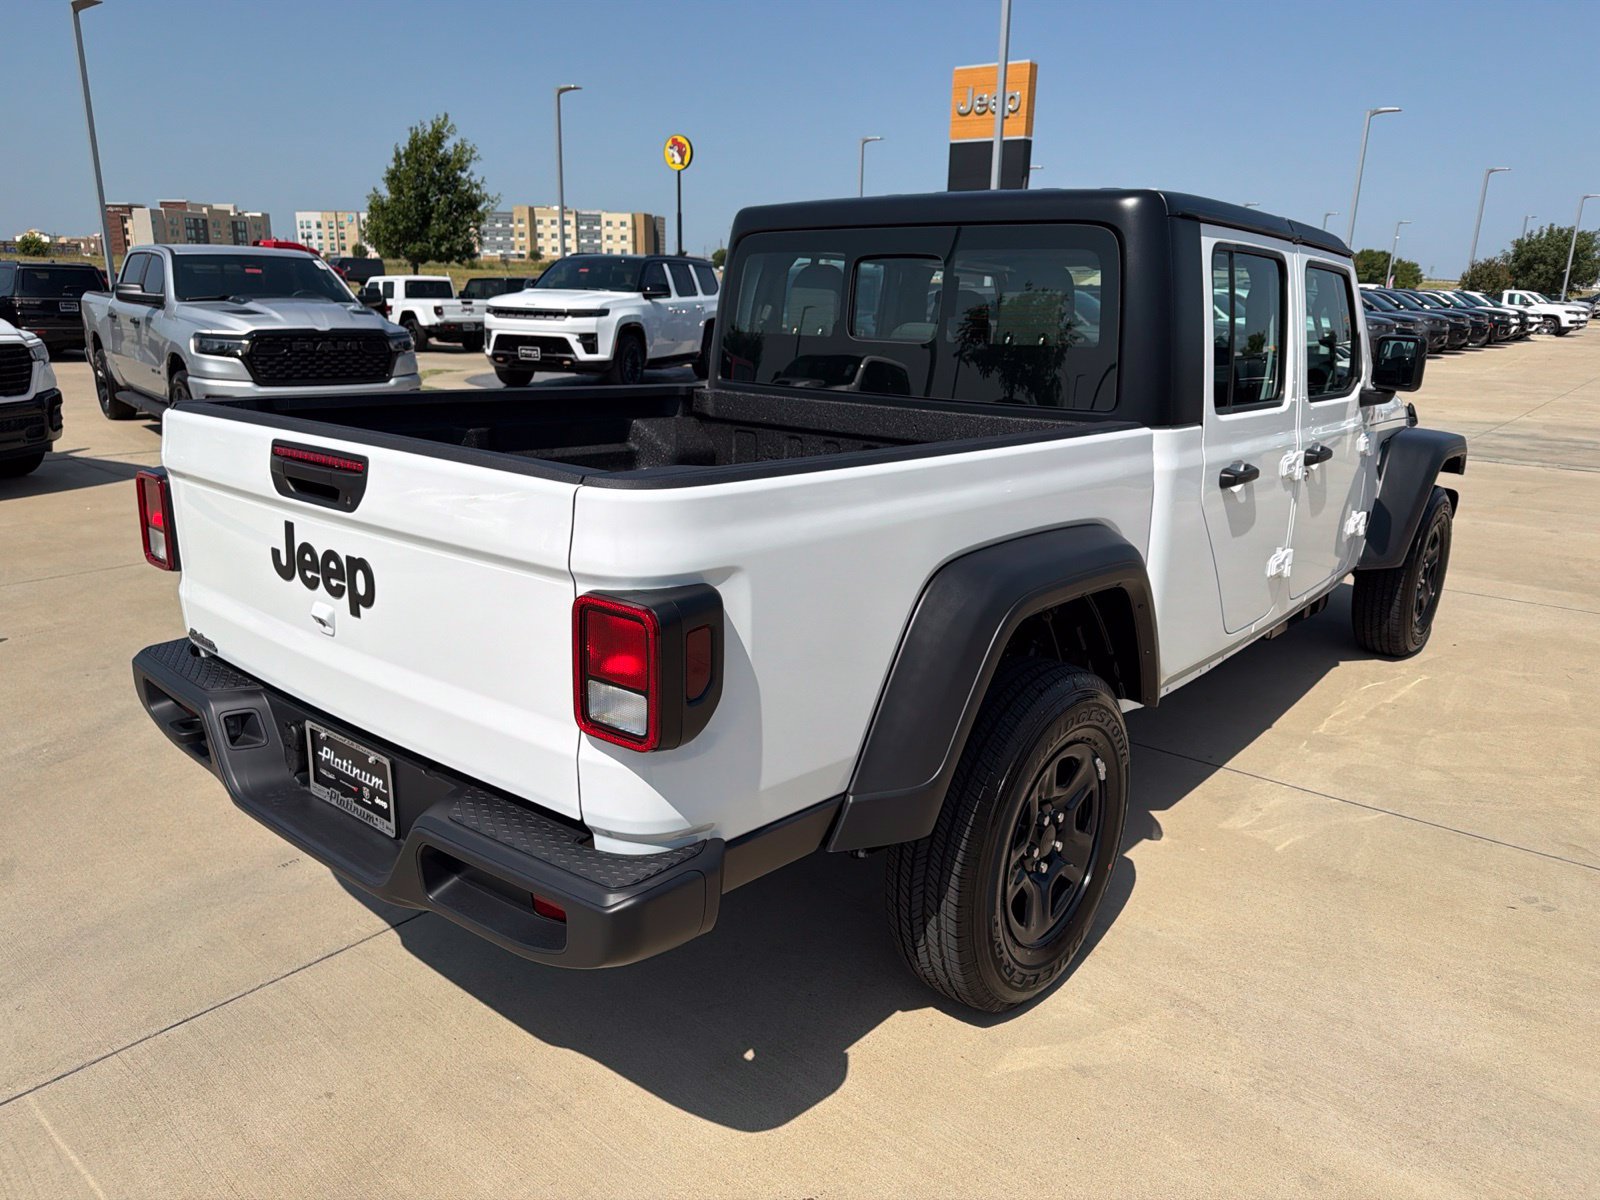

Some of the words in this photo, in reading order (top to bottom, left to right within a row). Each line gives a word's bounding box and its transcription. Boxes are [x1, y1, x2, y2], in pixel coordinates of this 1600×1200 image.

[956, 86, 1021, 118] Jeep
[291, 341, 359, 352] RAM
[271, 520, 375, 619] Jeep
[318, 746, 388, 793] Platinum
[329, 787, 379, 826] Platinum
